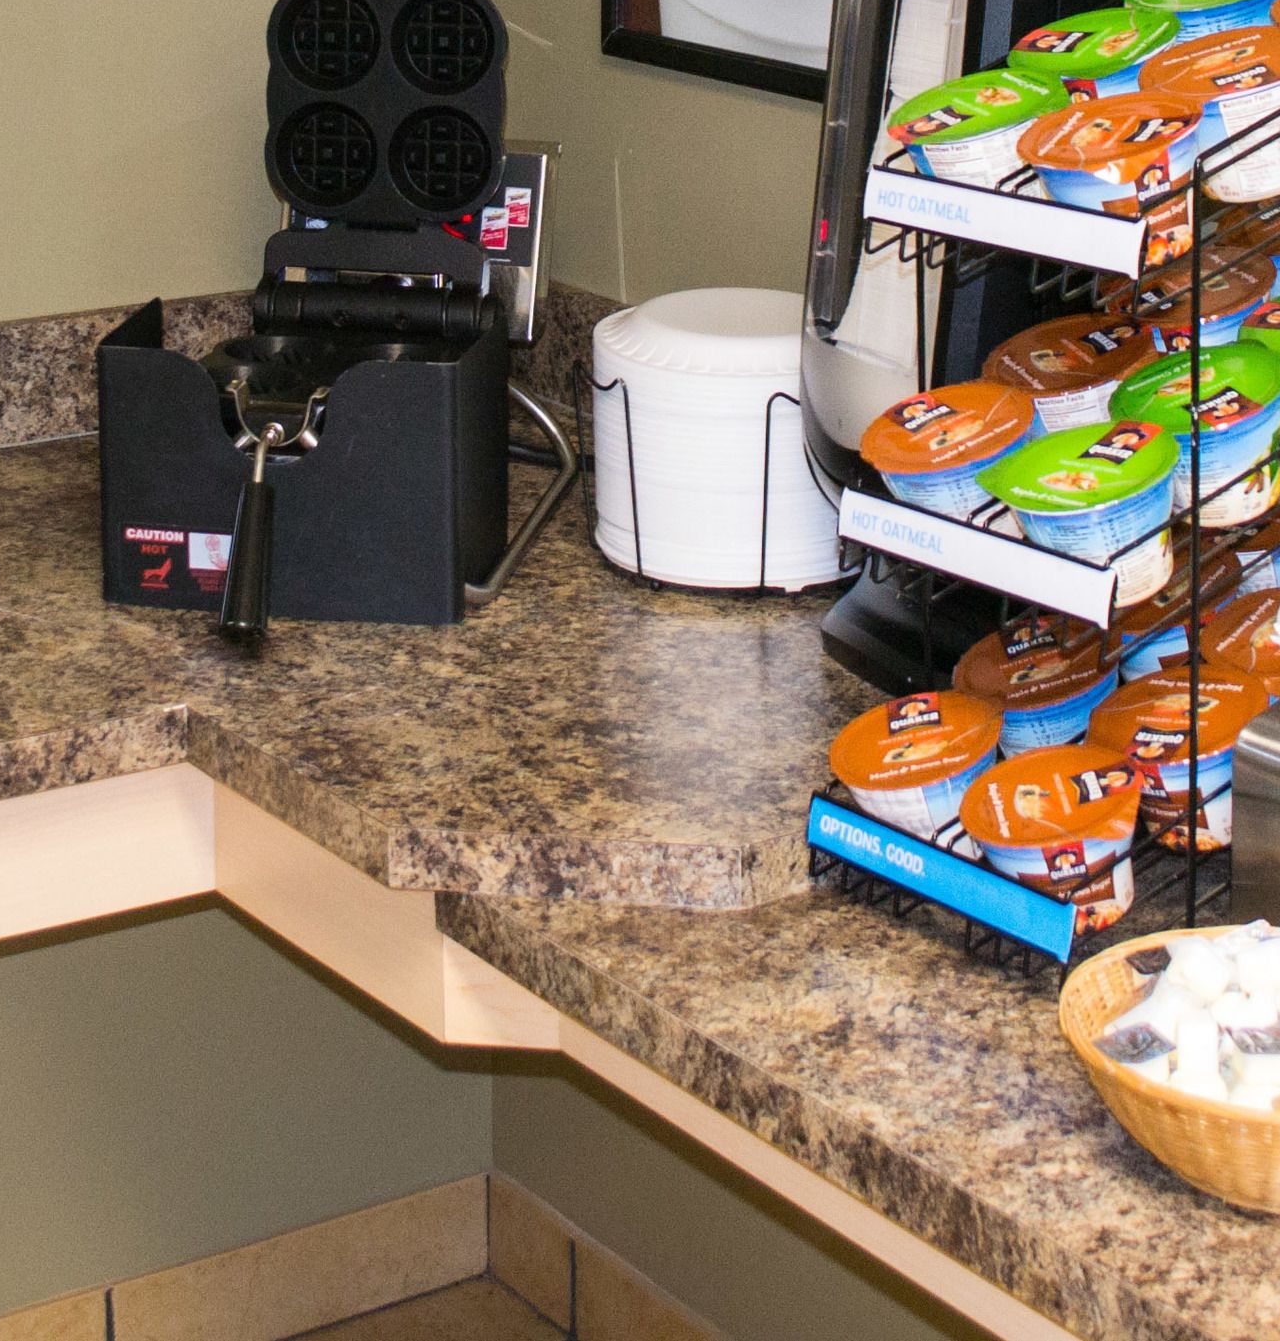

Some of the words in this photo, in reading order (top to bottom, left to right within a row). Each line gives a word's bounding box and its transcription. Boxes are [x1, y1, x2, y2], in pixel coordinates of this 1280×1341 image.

[1214, 66, 1268, 86] QUAKER
[877, 190, 905, 209] HOT
[908, 194, 971, 224] OATMEAL
[904, 405, 952, 430] QUAKER
[125, 527, 184, 543] CAUTION
[851, 509, 878, 531] HOT
[881, 519, 944, 555] OATMEAL
[141, 543, 169, 555] HOT
[890, 711, 940, 731] QUAKER
[1135, 731, 1185, 744] QUAKER
[820, 814, 884, 857] OPTIONS.
[1049, 864, 1087, 880] QUAKER
